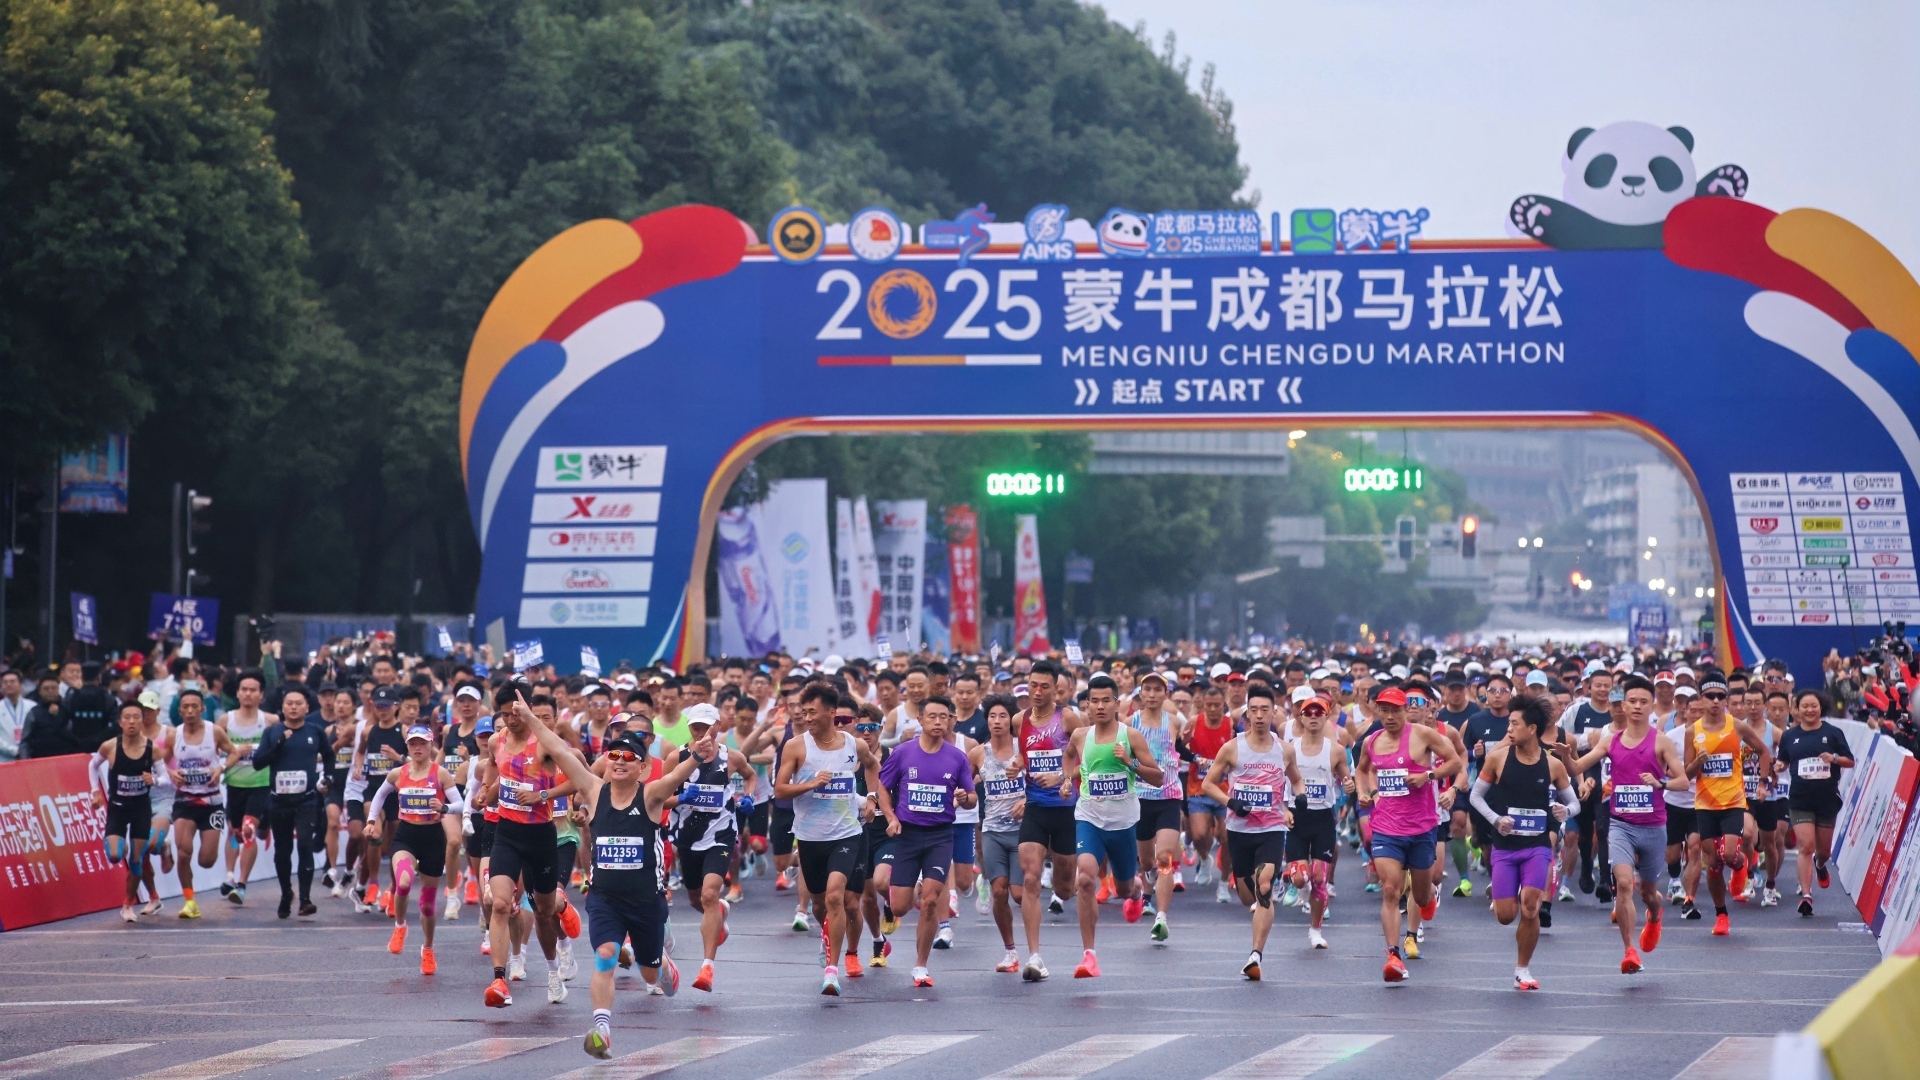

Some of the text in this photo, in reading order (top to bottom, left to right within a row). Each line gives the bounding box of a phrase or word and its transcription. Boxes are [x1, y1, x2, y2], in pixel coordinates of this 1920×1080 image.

[1155, 213, 1258, 234] 成都马拉松
[1340, 211, 1418, 250] 蒙牛
[1156, 237, 1258, 253] 2025 CHENGDU
[1204, 245, 1258, 253] MARATHON
[1022, 243, 1072, 261] AIMS
[816, 264, 1564, 341] 2025 蒙牛成都马拉松
[1062, 342, 1565, 367] MENGNIU CHENGDU MARATHON
[1112, 379, 1265, 404] 起点 START
[588, 453, 642, 480] 蒙牛
[987, 473, 1065, 496] 00:00:11
[1345, 468, 1422, 492] 00:00:11
[572, 531, 635, 545] 京东买药
[1031, 757, 1059, 768] A10021
[1243, 763, 1276, 771] saucony
[1703, 760, 1730, 770] A10431
[990, 780, 1020, 791] A10012
[1092, 780, 1124, 791] A10010
[1380, 777, 1405, 787] A10144
[911, 791, 942, 803] A10804
[1237, 791, 1268, 802] A10034
[1618, 793, 1649, 803] A10016
[601, 846, 638, 858] A12359
